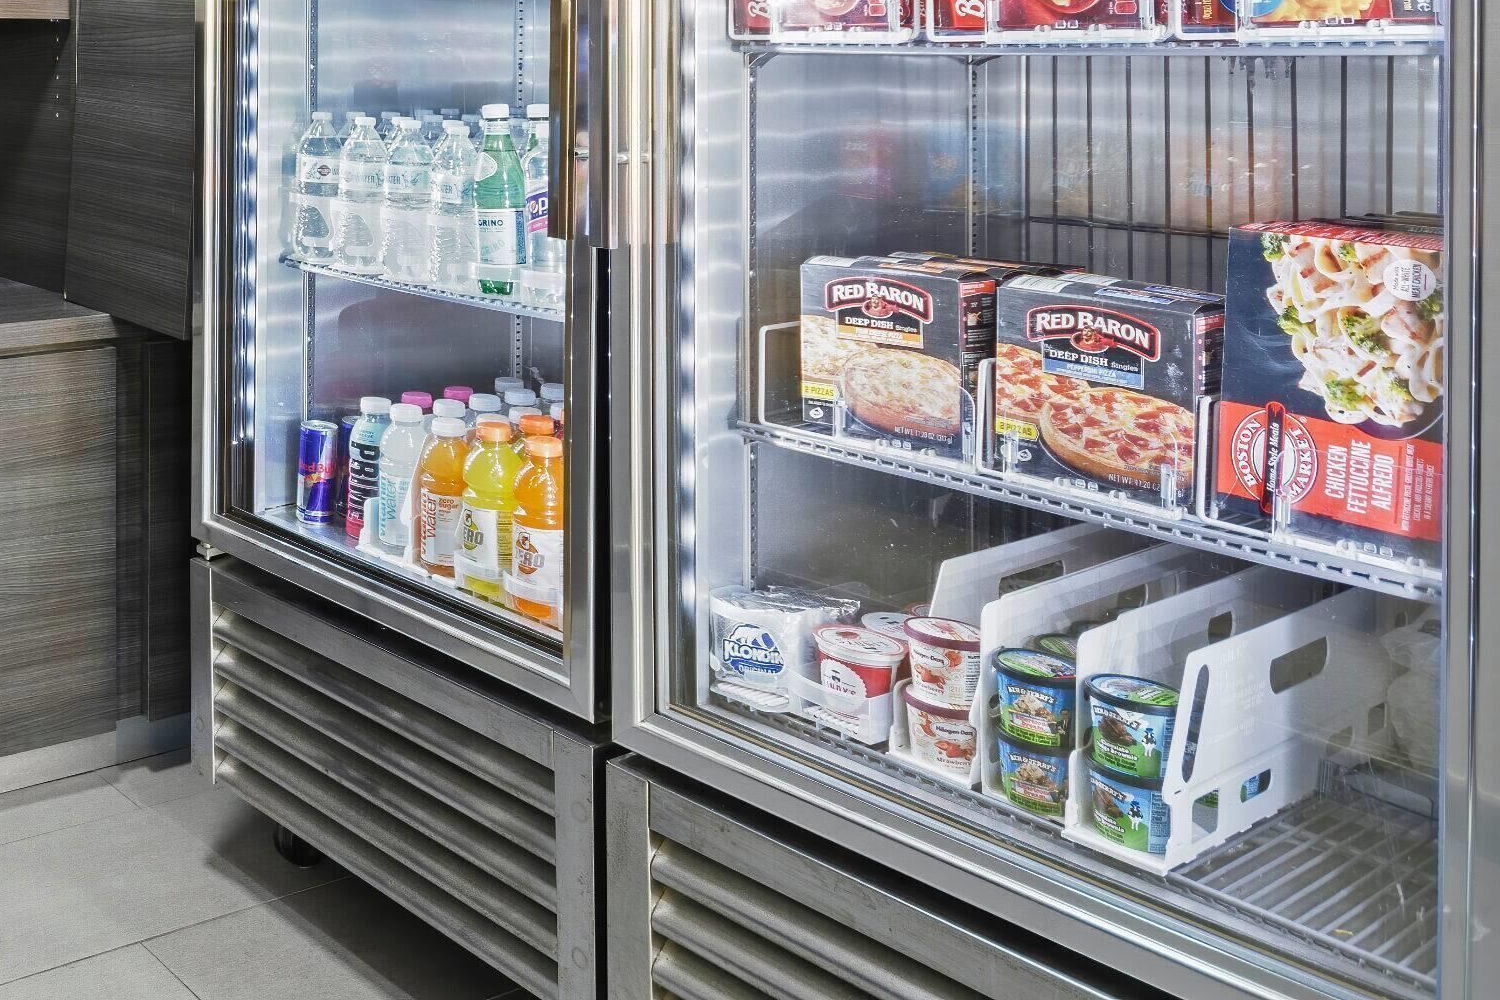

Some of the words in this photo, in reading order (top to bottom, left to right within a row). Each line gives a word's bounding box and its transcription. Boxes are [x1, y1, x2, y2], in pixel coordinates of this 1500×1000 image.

[1412, 263, 1422, 285] CHICKEN
[832, 283, 864, 304] RED
[866, 281, 925, 314] BARON
[1411, 285, 1421, 298] MEAT
[844, 315, 869, 326] DEEP
[870, 318, 894, 330] DISH
[1035, 312, 1075, 332] RED
[1077, 311, 1150, 349] BARON
[1049, 349, 1080, 363] DEEP
[1080, 353, 1109, 368] DISH
[1110, 361, 1139, 372] Singles
[803, 384, 810, 394] 2
[809, 384, 834, 397] PIZZAS
[894, 426, 904, 435] NET
[999, 421, 1006, 431] 2
[1006, 422, 1033, 436] PIZZAS
[1267, 421, 1281, 447] Meals
[1236, 418, 1263, 487] BOSTON
[1268, 447, 1279, 467] Style
[1288, 427, 1312, 499] MARKET
[1108, 472, 1121, 483] NET
[1266, 468, 1276, 492] Home
[1325, 444, 1348, 499] CHICKEN
[1347, 439, 1371, 514] FETTUCCINE
[1370, 454, 1394, 511] ALFREDO
[386, 479, 397, 520] water
[438, 502, 459, 510] sugar
[426, 495, 437, 539] water
[1007, 686, 1021, 695] BEN
[1026, 690, 1055, 704] JERRY'S
[1009, 754, 1024, 762] BEN
[1028, 757, 1057, 773] JERRY'S
